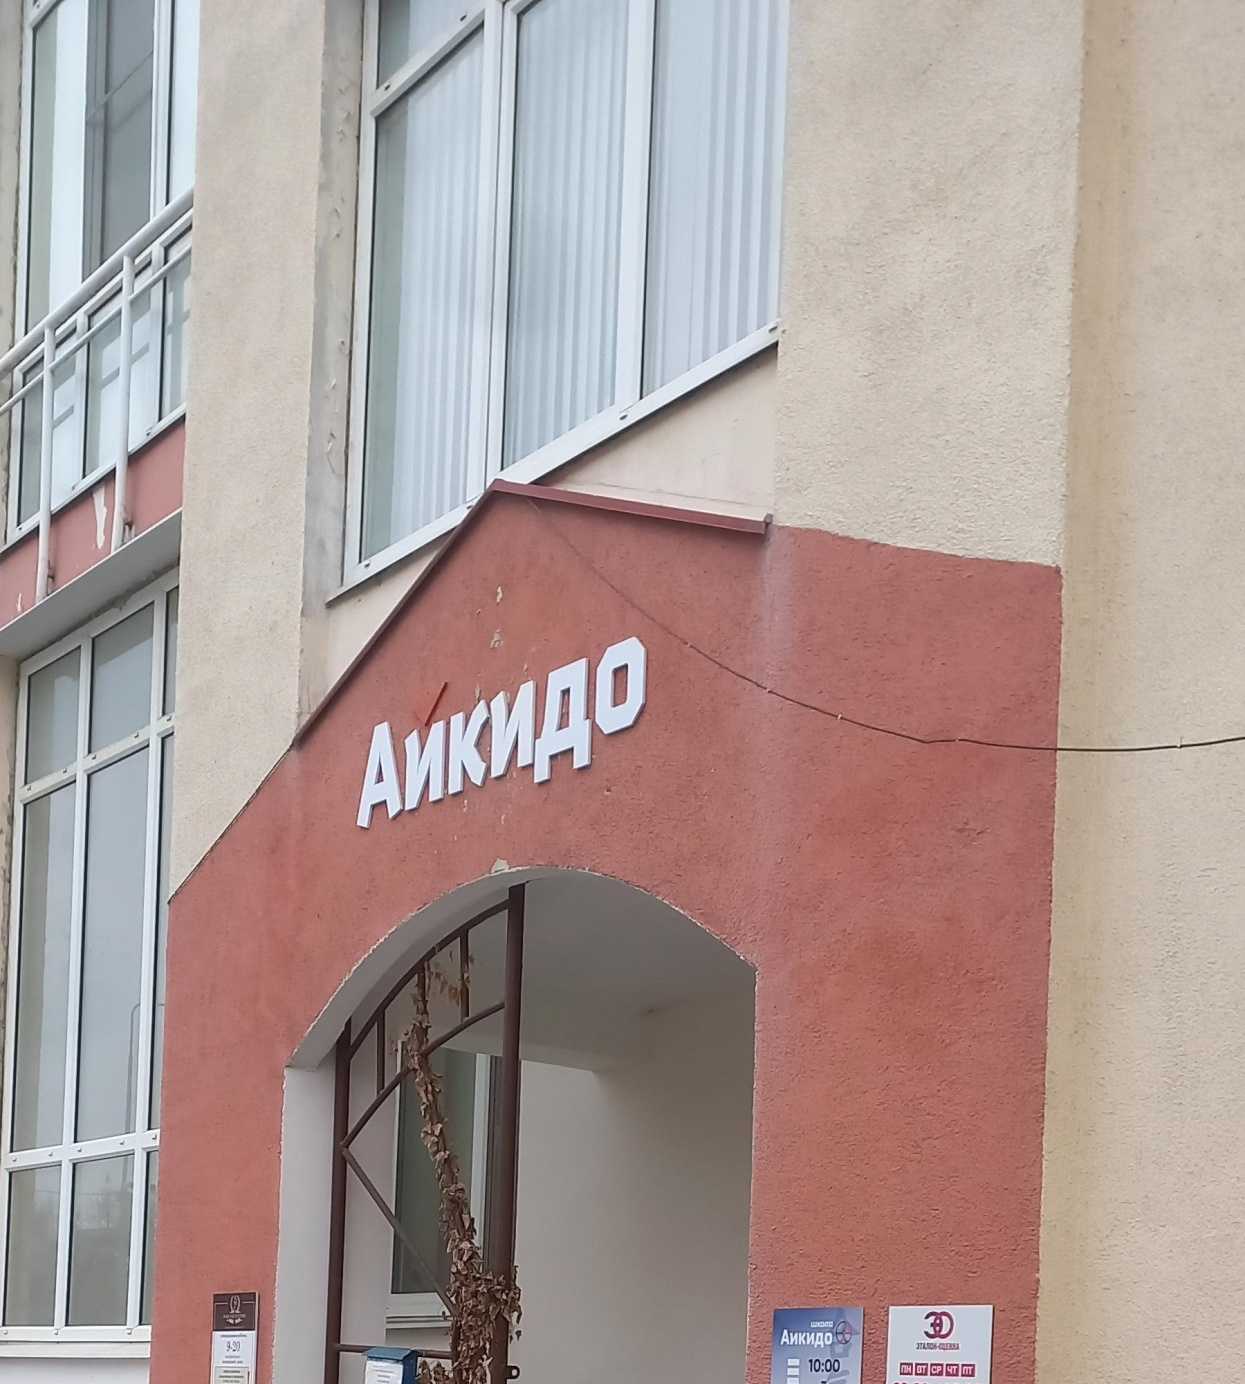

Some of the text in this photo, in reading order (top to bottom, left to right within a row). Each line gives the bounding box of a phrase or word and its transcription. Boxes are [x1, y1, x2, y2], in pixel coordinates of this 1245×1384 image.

[808, 1359, 841, 1372] 10:00
[901, 1365, 974, 1374] ПН ВТ СР ЧТ ПТ
